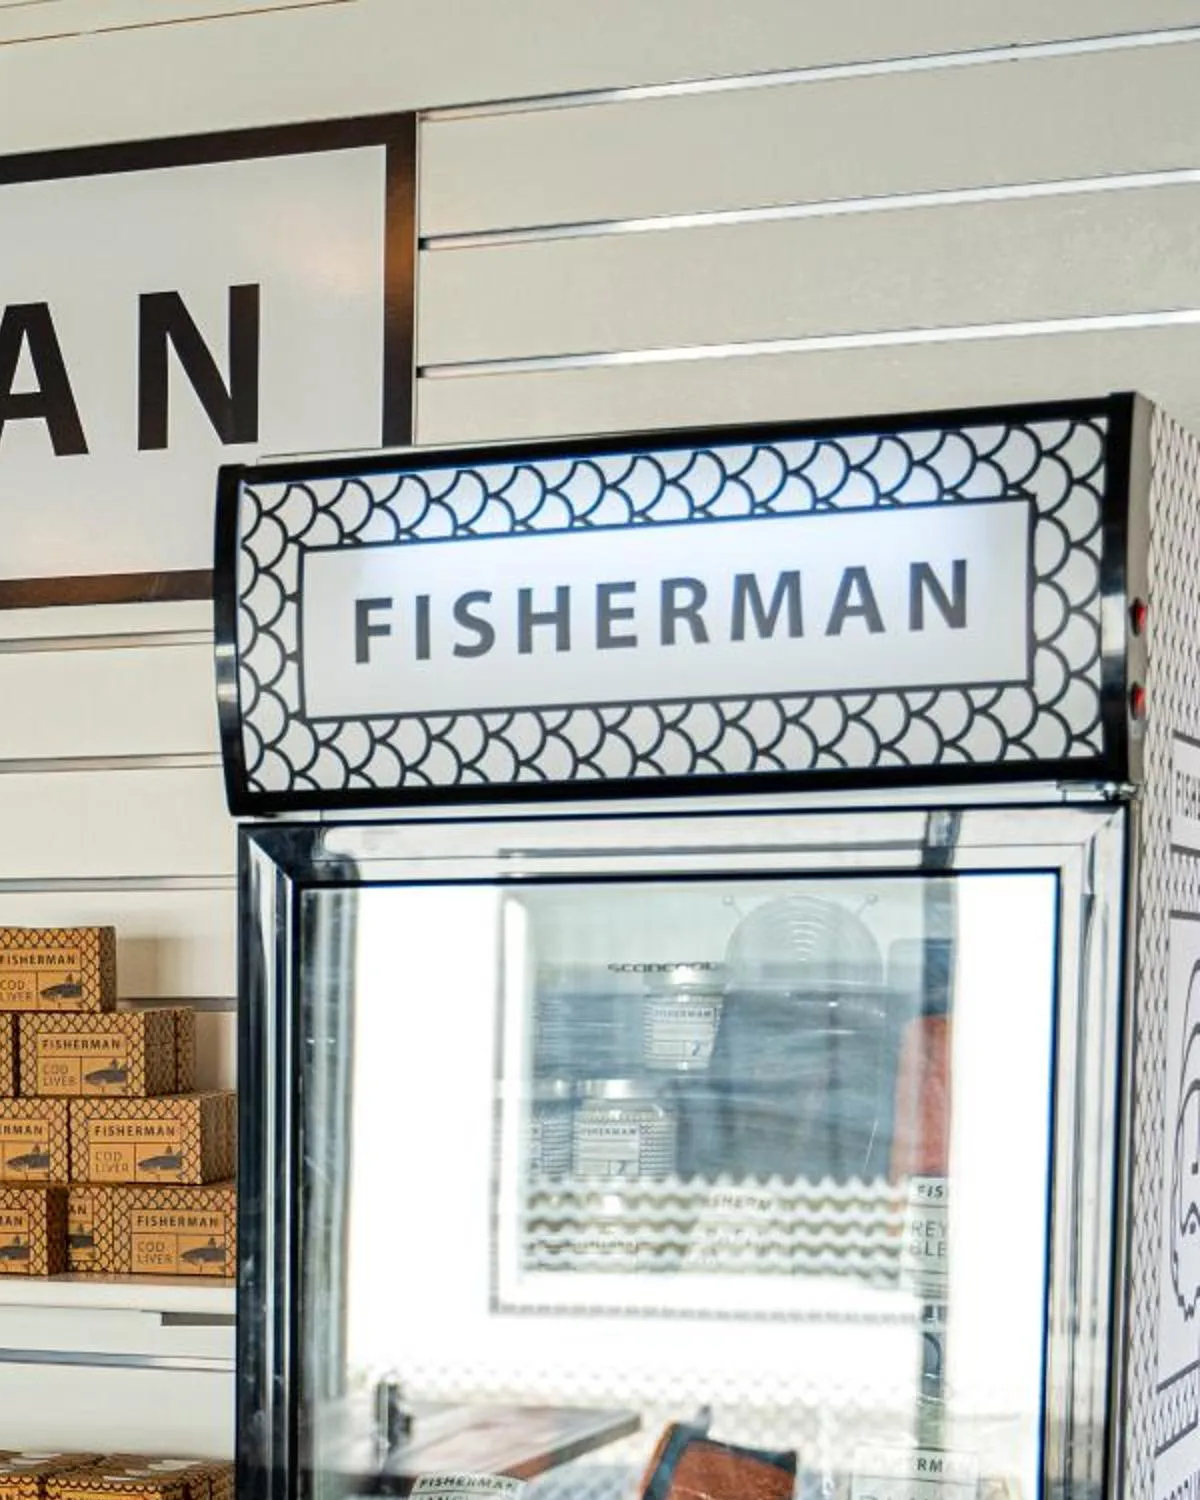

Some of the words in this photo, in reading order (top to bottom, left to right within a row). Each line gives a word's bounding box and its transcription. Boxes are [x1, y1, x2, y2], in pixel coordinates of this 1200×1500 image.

[353, 558, 969, 664] FISHERMAN
[0, 954, 76, 965] FISHERMAN
[0, 979, 25, 990] COD
[43, 1039, 121, 1049] FISHERMAN
[43, 1064, 69, 1074] COD
[94, 1125, 176, 1137] FISHERMAN
[95, 1151, 122, 1162] COD
[137, 1215, 219, 1228] FISHERMAN
[137, 1241, 165, 1252] COD
